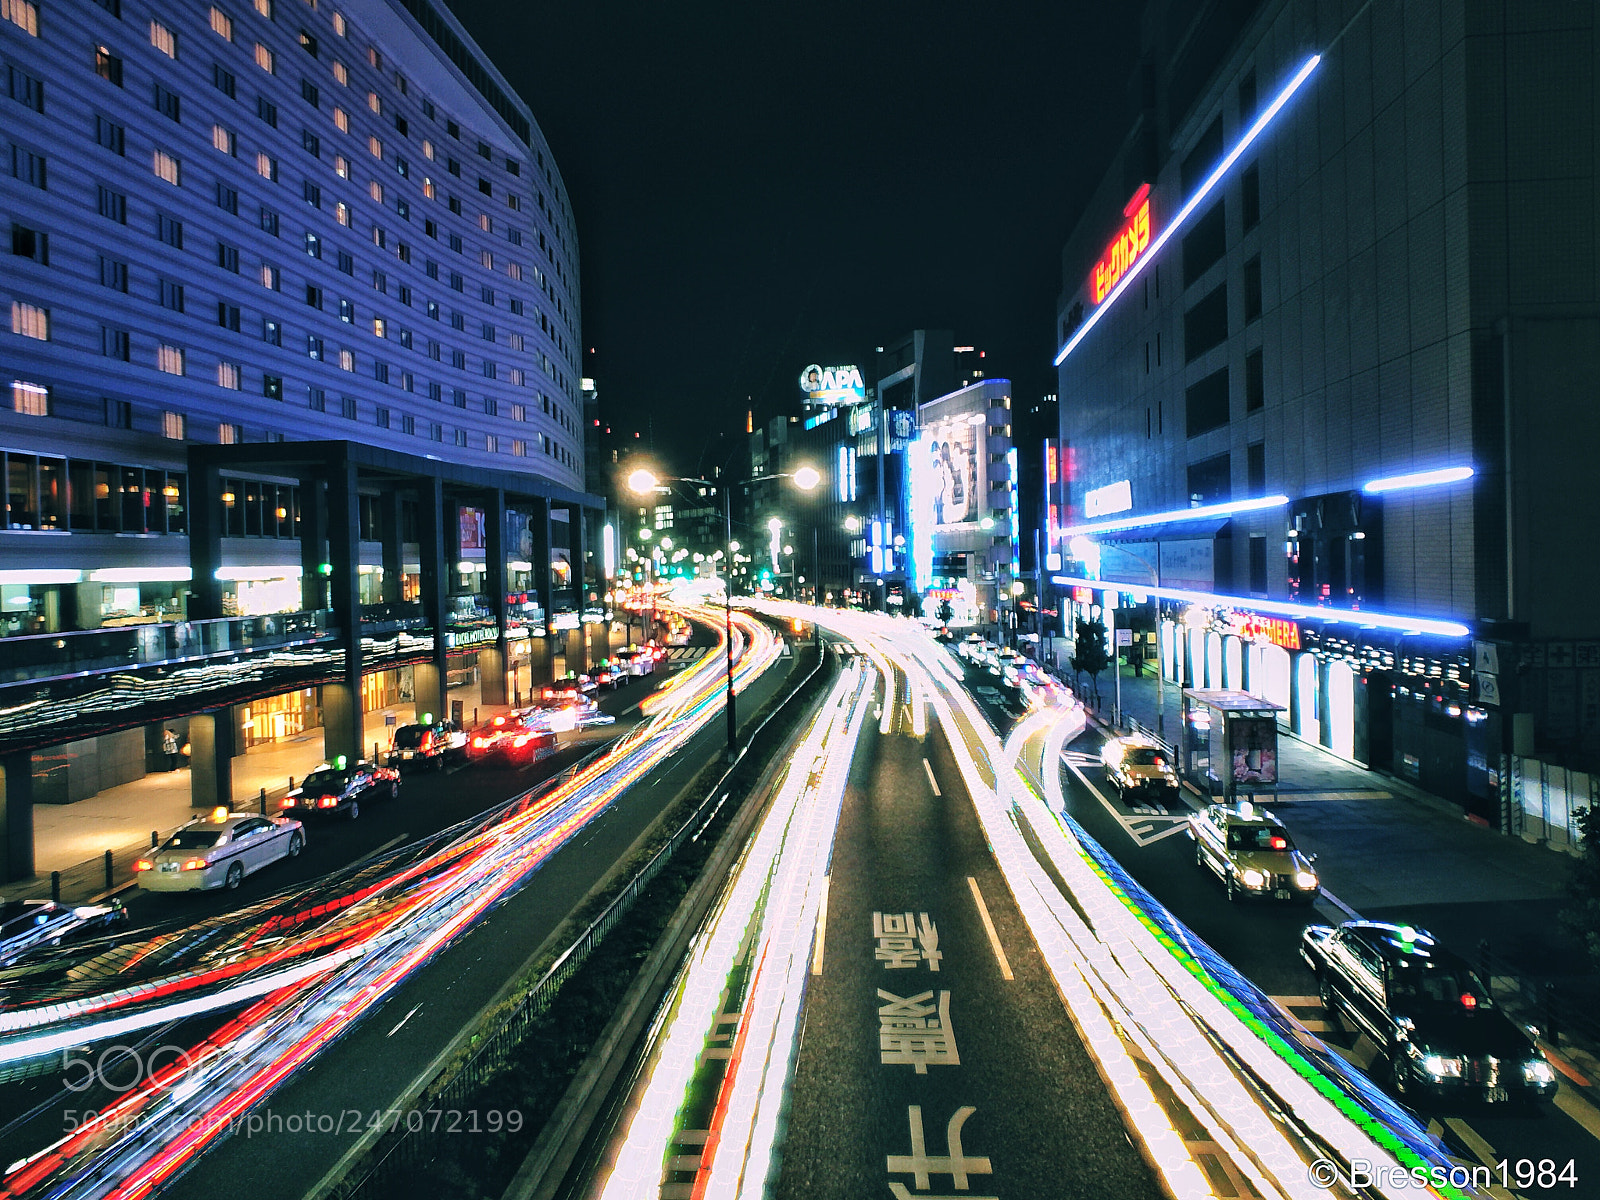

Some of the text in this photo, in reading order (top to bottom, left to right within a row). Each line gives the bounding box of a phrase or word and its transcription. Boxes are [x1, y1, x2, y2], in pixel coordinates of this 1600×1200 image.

[1095, 198, 1151, 305] ビックカメラ
[821, 369, 864, 391] APA
[455, 632, 470, 646] EXCEL
[470, 629, 484, 643] HOTEL
